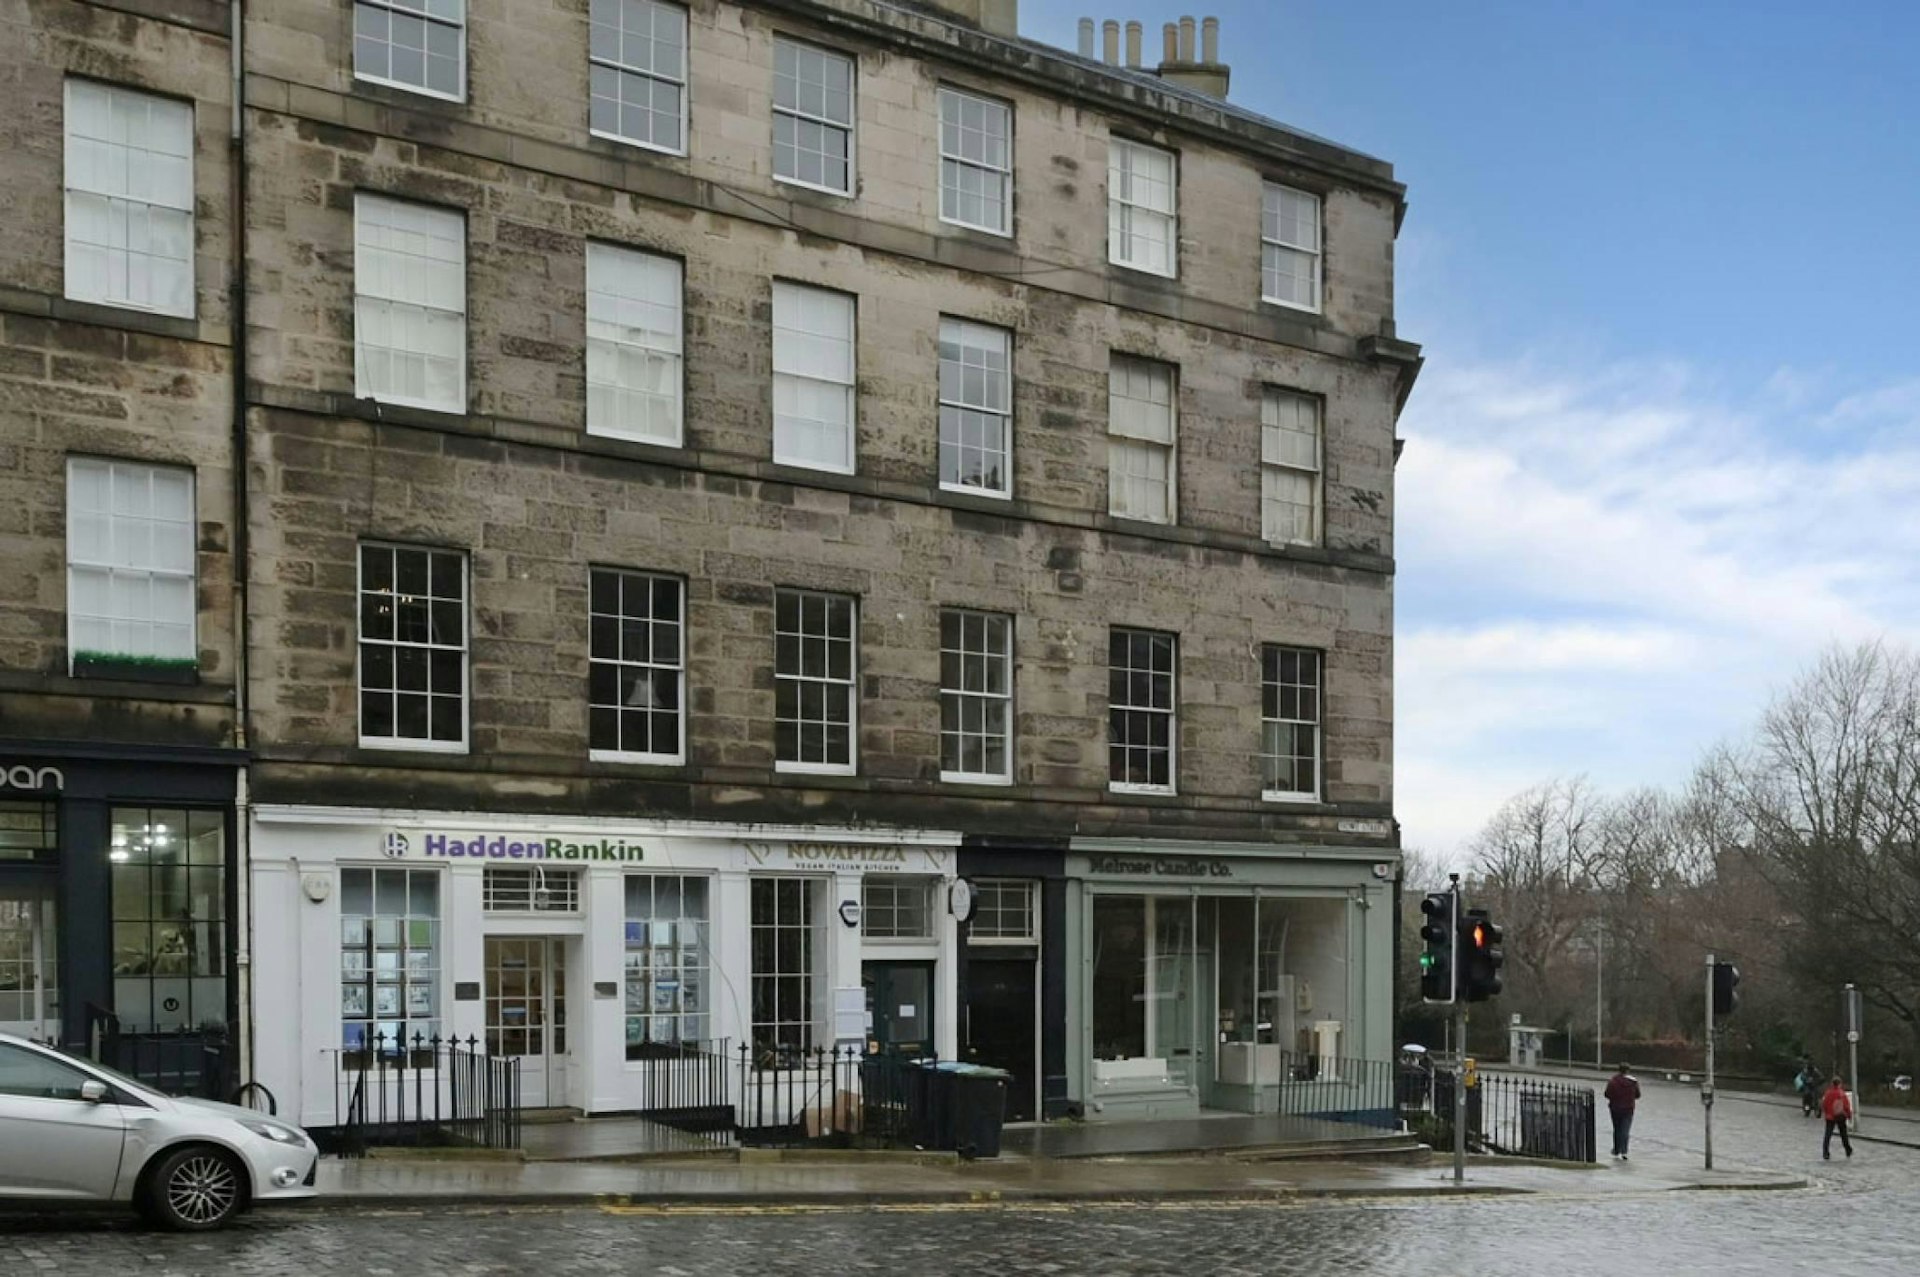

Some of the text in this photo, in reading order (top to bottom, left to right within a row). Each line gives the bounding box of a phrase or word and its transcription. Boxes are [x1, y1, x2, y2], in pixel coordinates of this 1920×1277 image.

[0, 765, 64, 790] an
[425, 834, 644, 861] HaddenRankin
[787, 843, 907, 862] NOVAPIZZA
